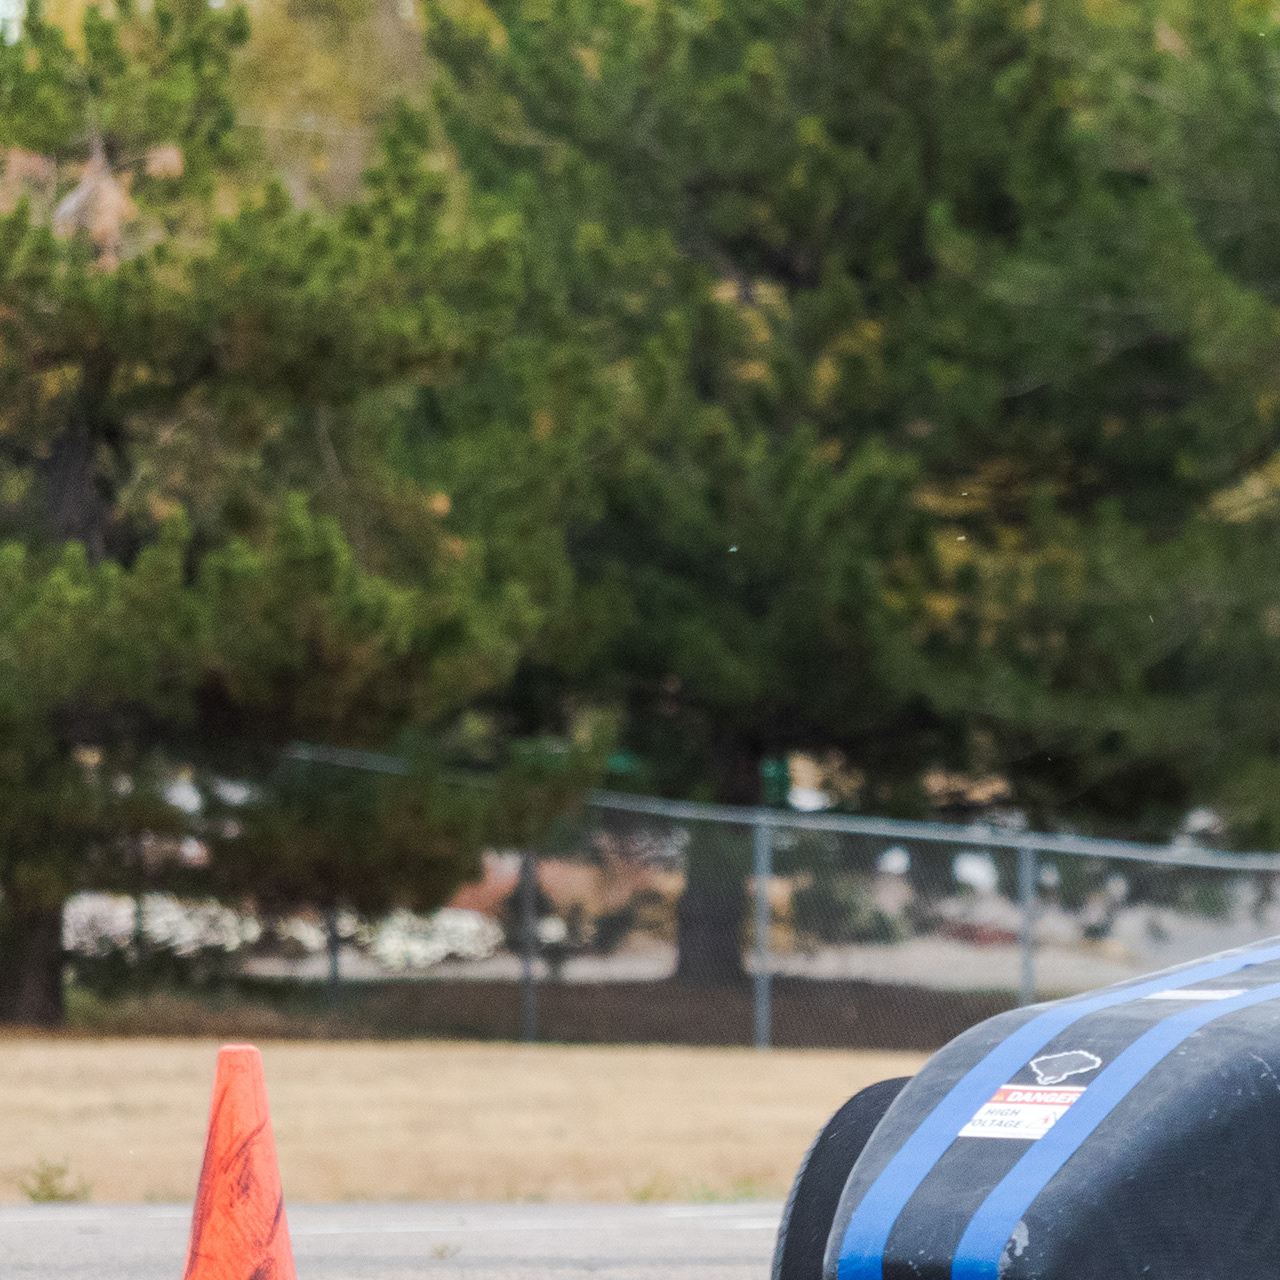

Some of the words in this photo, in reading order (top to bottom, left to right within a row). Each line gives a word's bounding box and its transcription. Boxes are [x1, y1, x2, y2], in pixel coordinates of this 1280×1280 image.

[1006, 1091, 1081, 1103] DANGER
[984, 1108, 1022, 1117] HIGH
[970, 1118, 1024, 1129] OLTAGE
